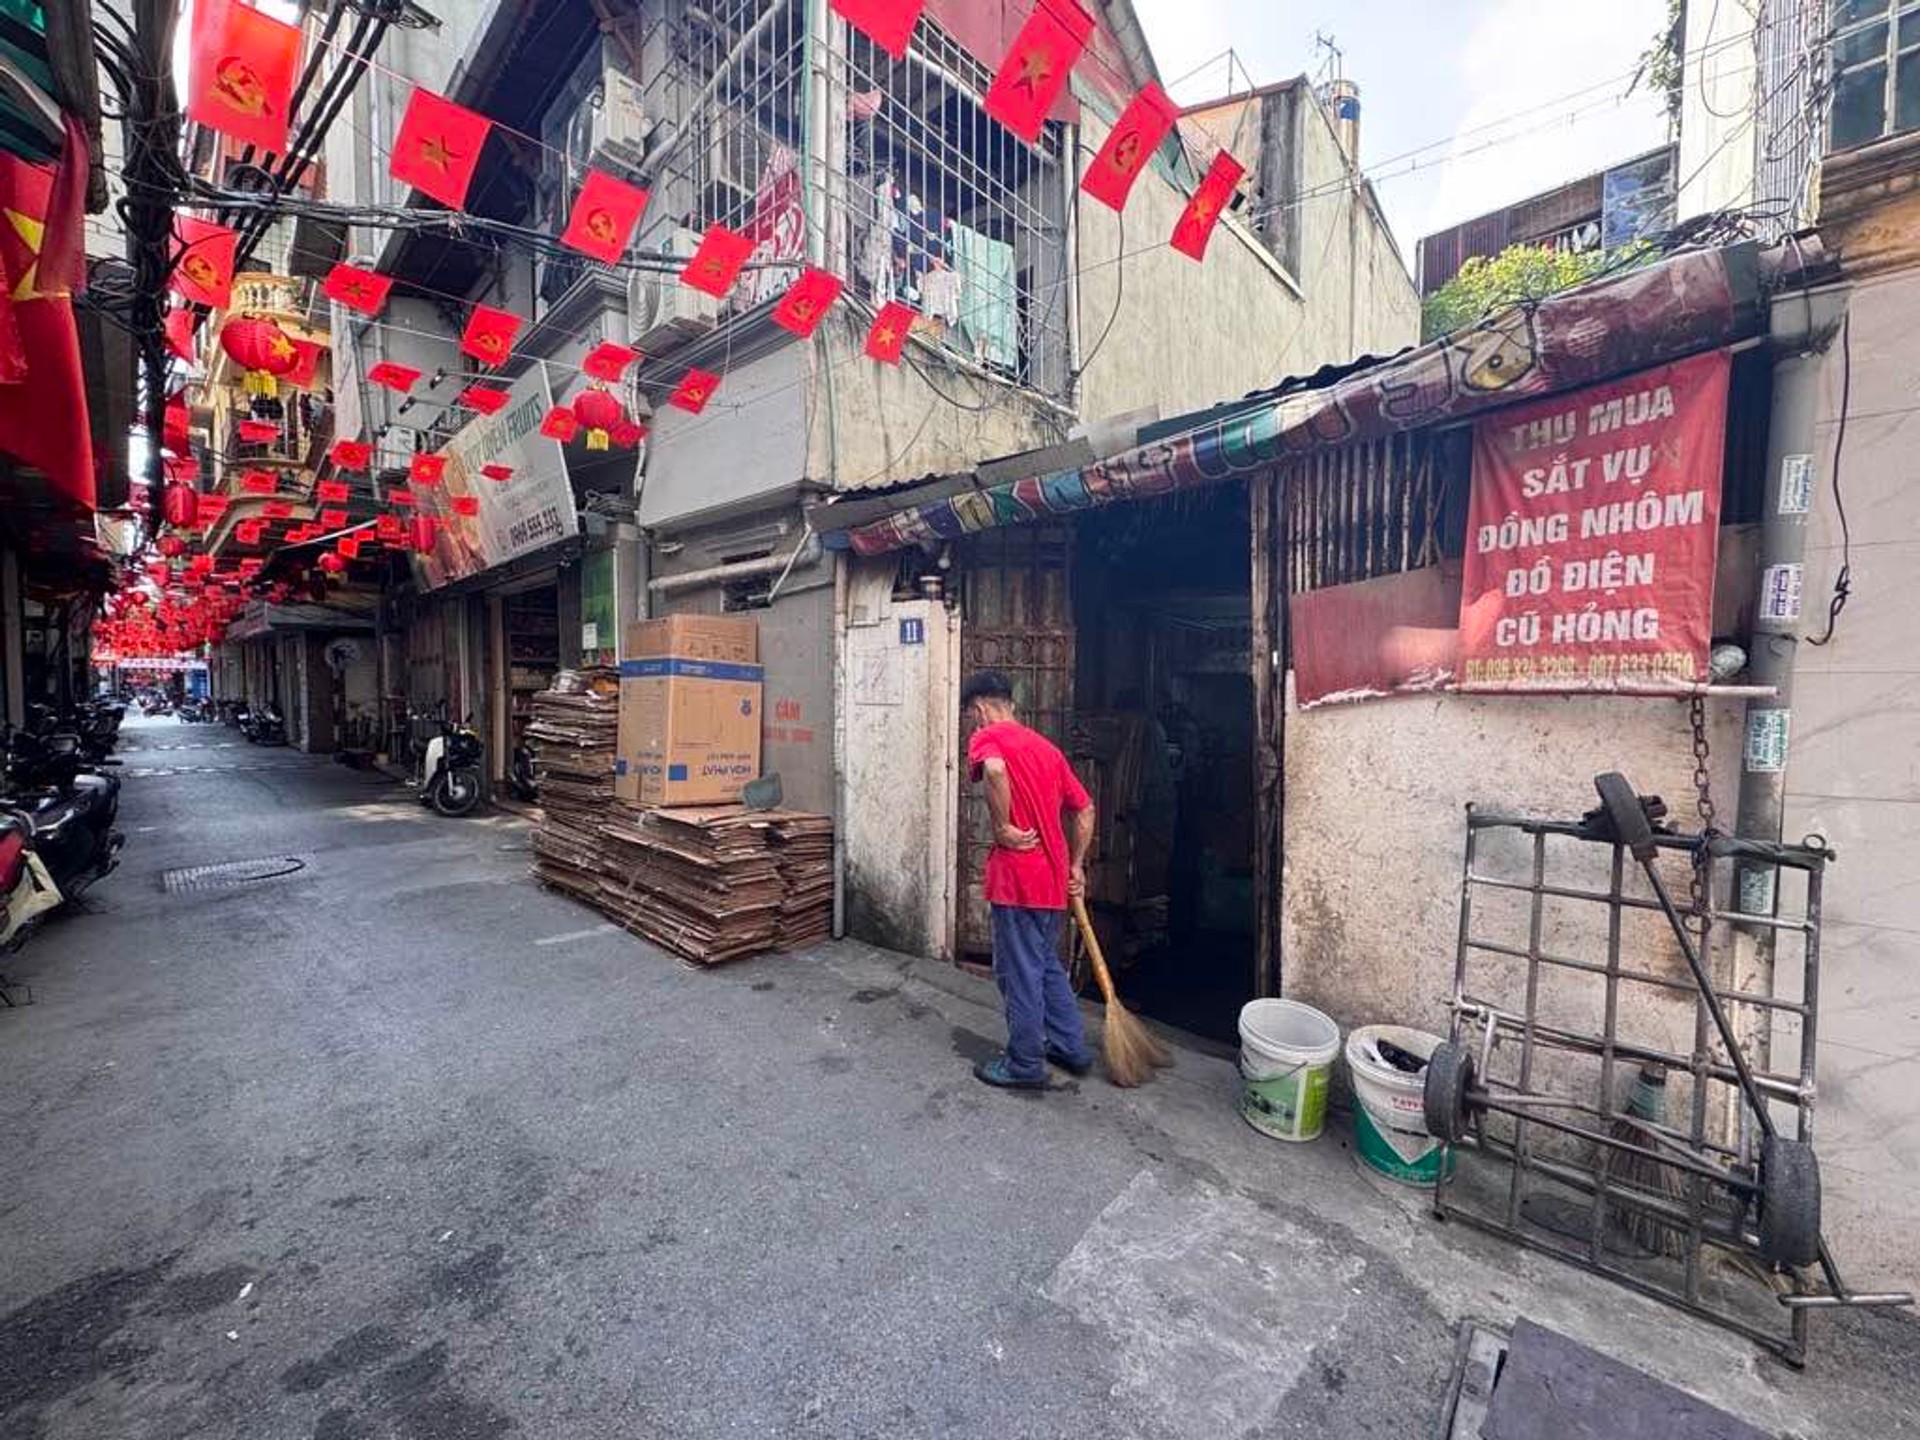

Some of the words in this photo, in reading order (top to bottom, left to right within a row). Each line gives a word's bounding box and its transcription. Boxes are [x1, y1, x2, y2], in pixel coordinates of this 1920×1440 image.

[1510, 411, 1577, 451] THU
[1588, 385, 1675, 436] MUA
[1522, 452, 1591, 499] SẮT
[1602, 444, 1652, 485] VỤ
[1478, 511, 1569, 553] ĐỒNG
[1581, 490, 1705, 541] NHÔM
[1506, 555, 1552, 598] ĐỒ
[1562, 550, 1656, 596] ĐIỆN
[905, 621, 918, 641] 11
[1496, 610, 1541, 647] CŨ
[1553, 601, 1660, 645] HỎNG
